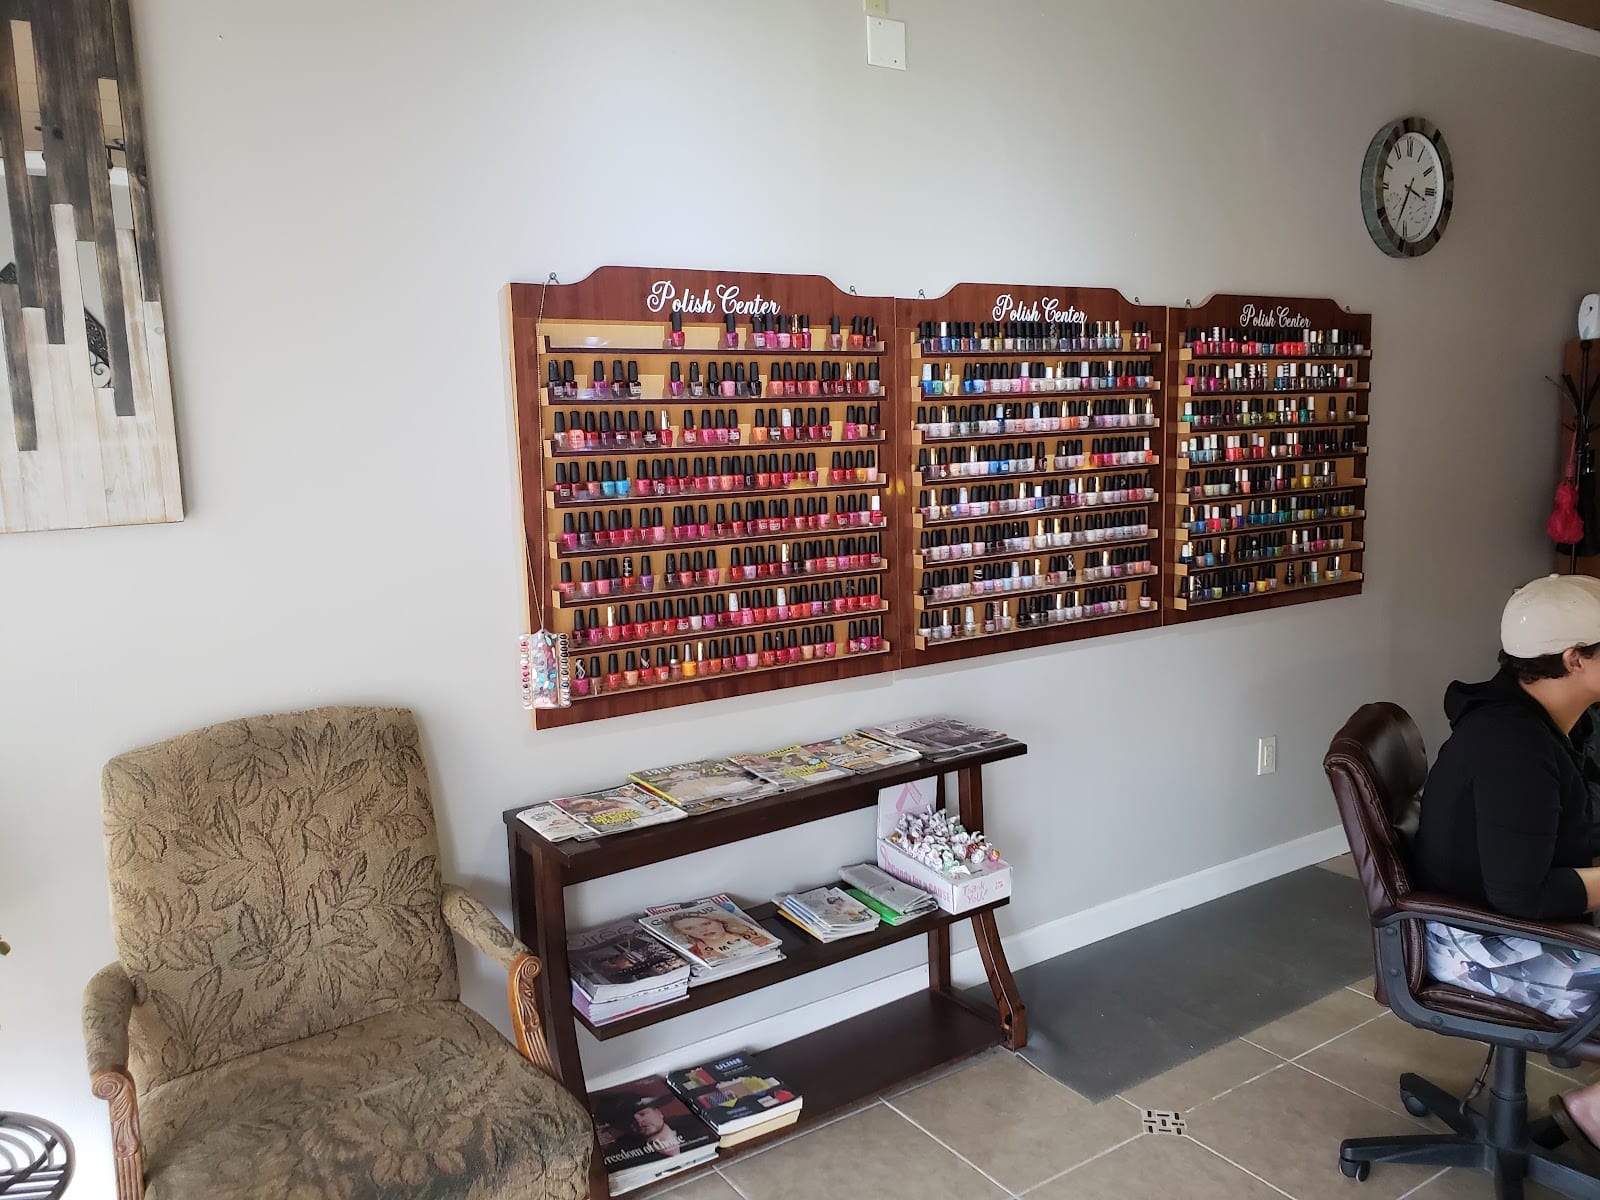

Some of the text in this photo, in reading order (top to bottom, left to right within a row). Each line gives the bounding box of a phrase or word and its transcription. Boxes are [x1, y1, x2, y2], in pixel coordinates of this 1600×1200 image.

[646, 280, 781, 316] Polish Center
[992, 294, 1088, 324] Polish Center
[1239, 303, 1312, 329] Polish Center
[650, 906, 717, 926] GLOUR
[643, 1139, 655, 1154] of
